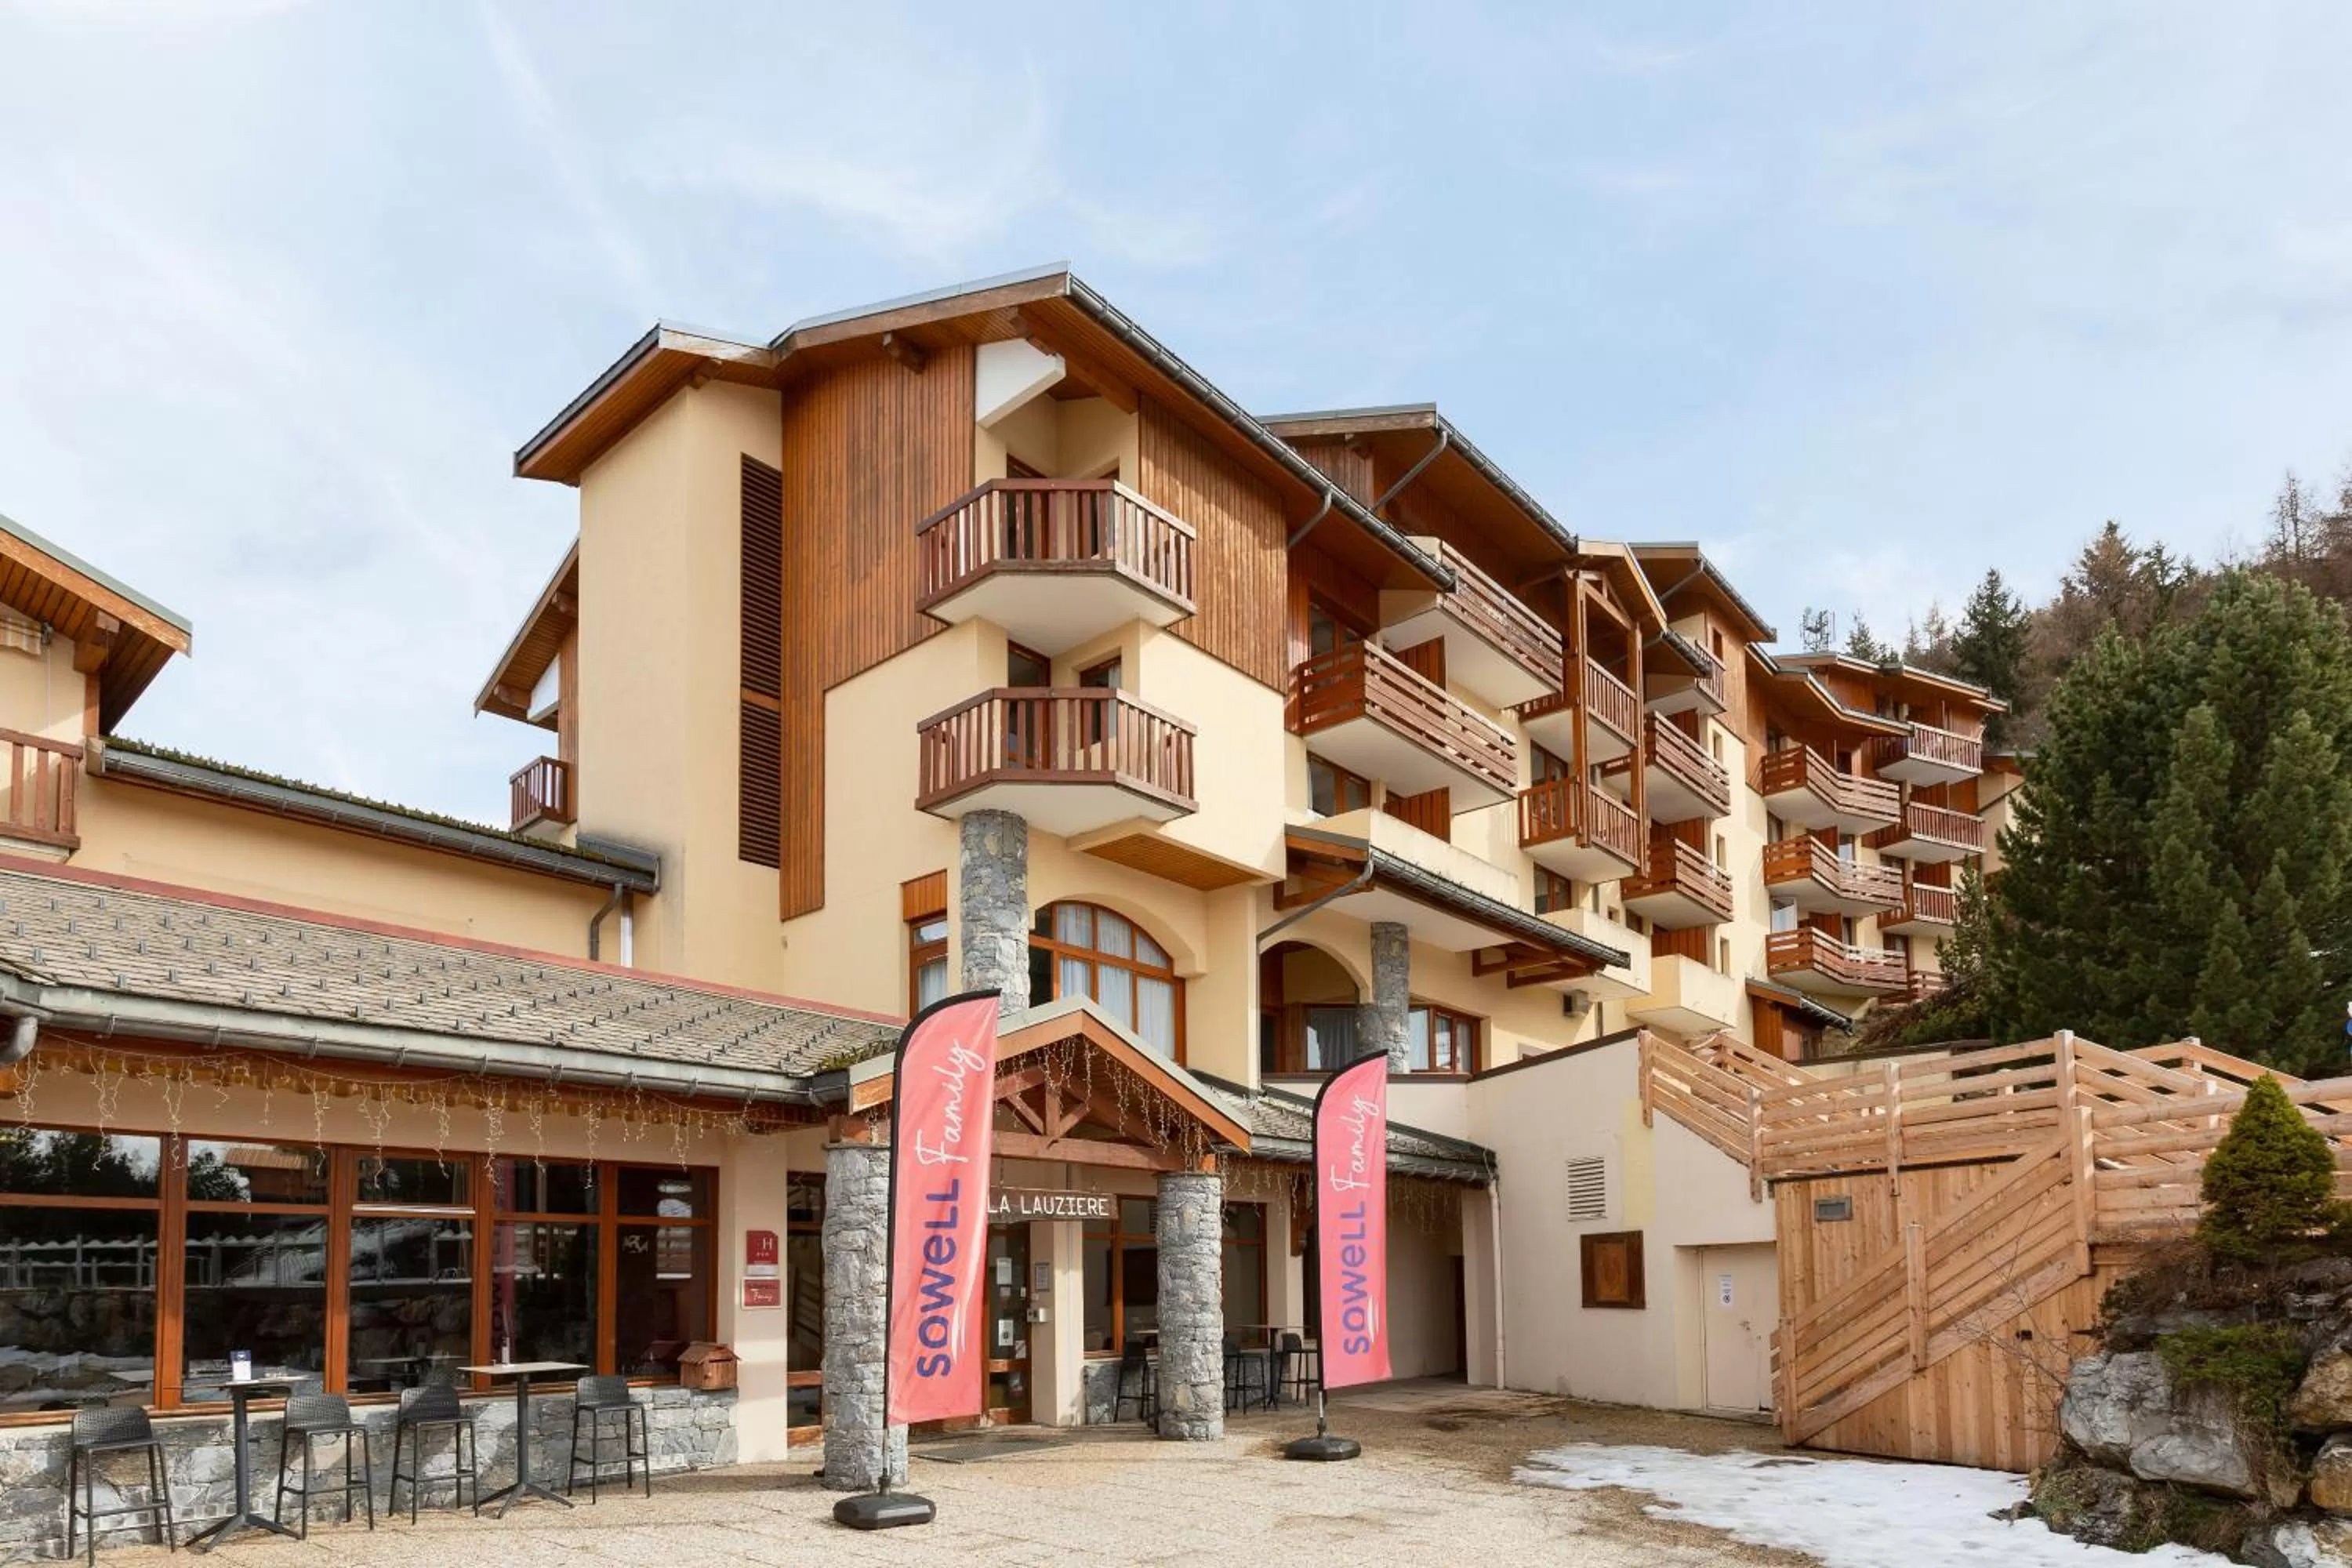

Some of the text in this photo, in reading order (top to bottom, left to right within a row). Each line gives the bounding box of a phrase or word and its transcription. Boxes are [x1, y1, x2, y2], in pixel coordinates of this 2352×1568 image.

[915, 1038, 985, 1165] Family
[1330, 1094, 1379, 1192] Family
[987, 1194, 1109, 1216] LA LAUZIERE
